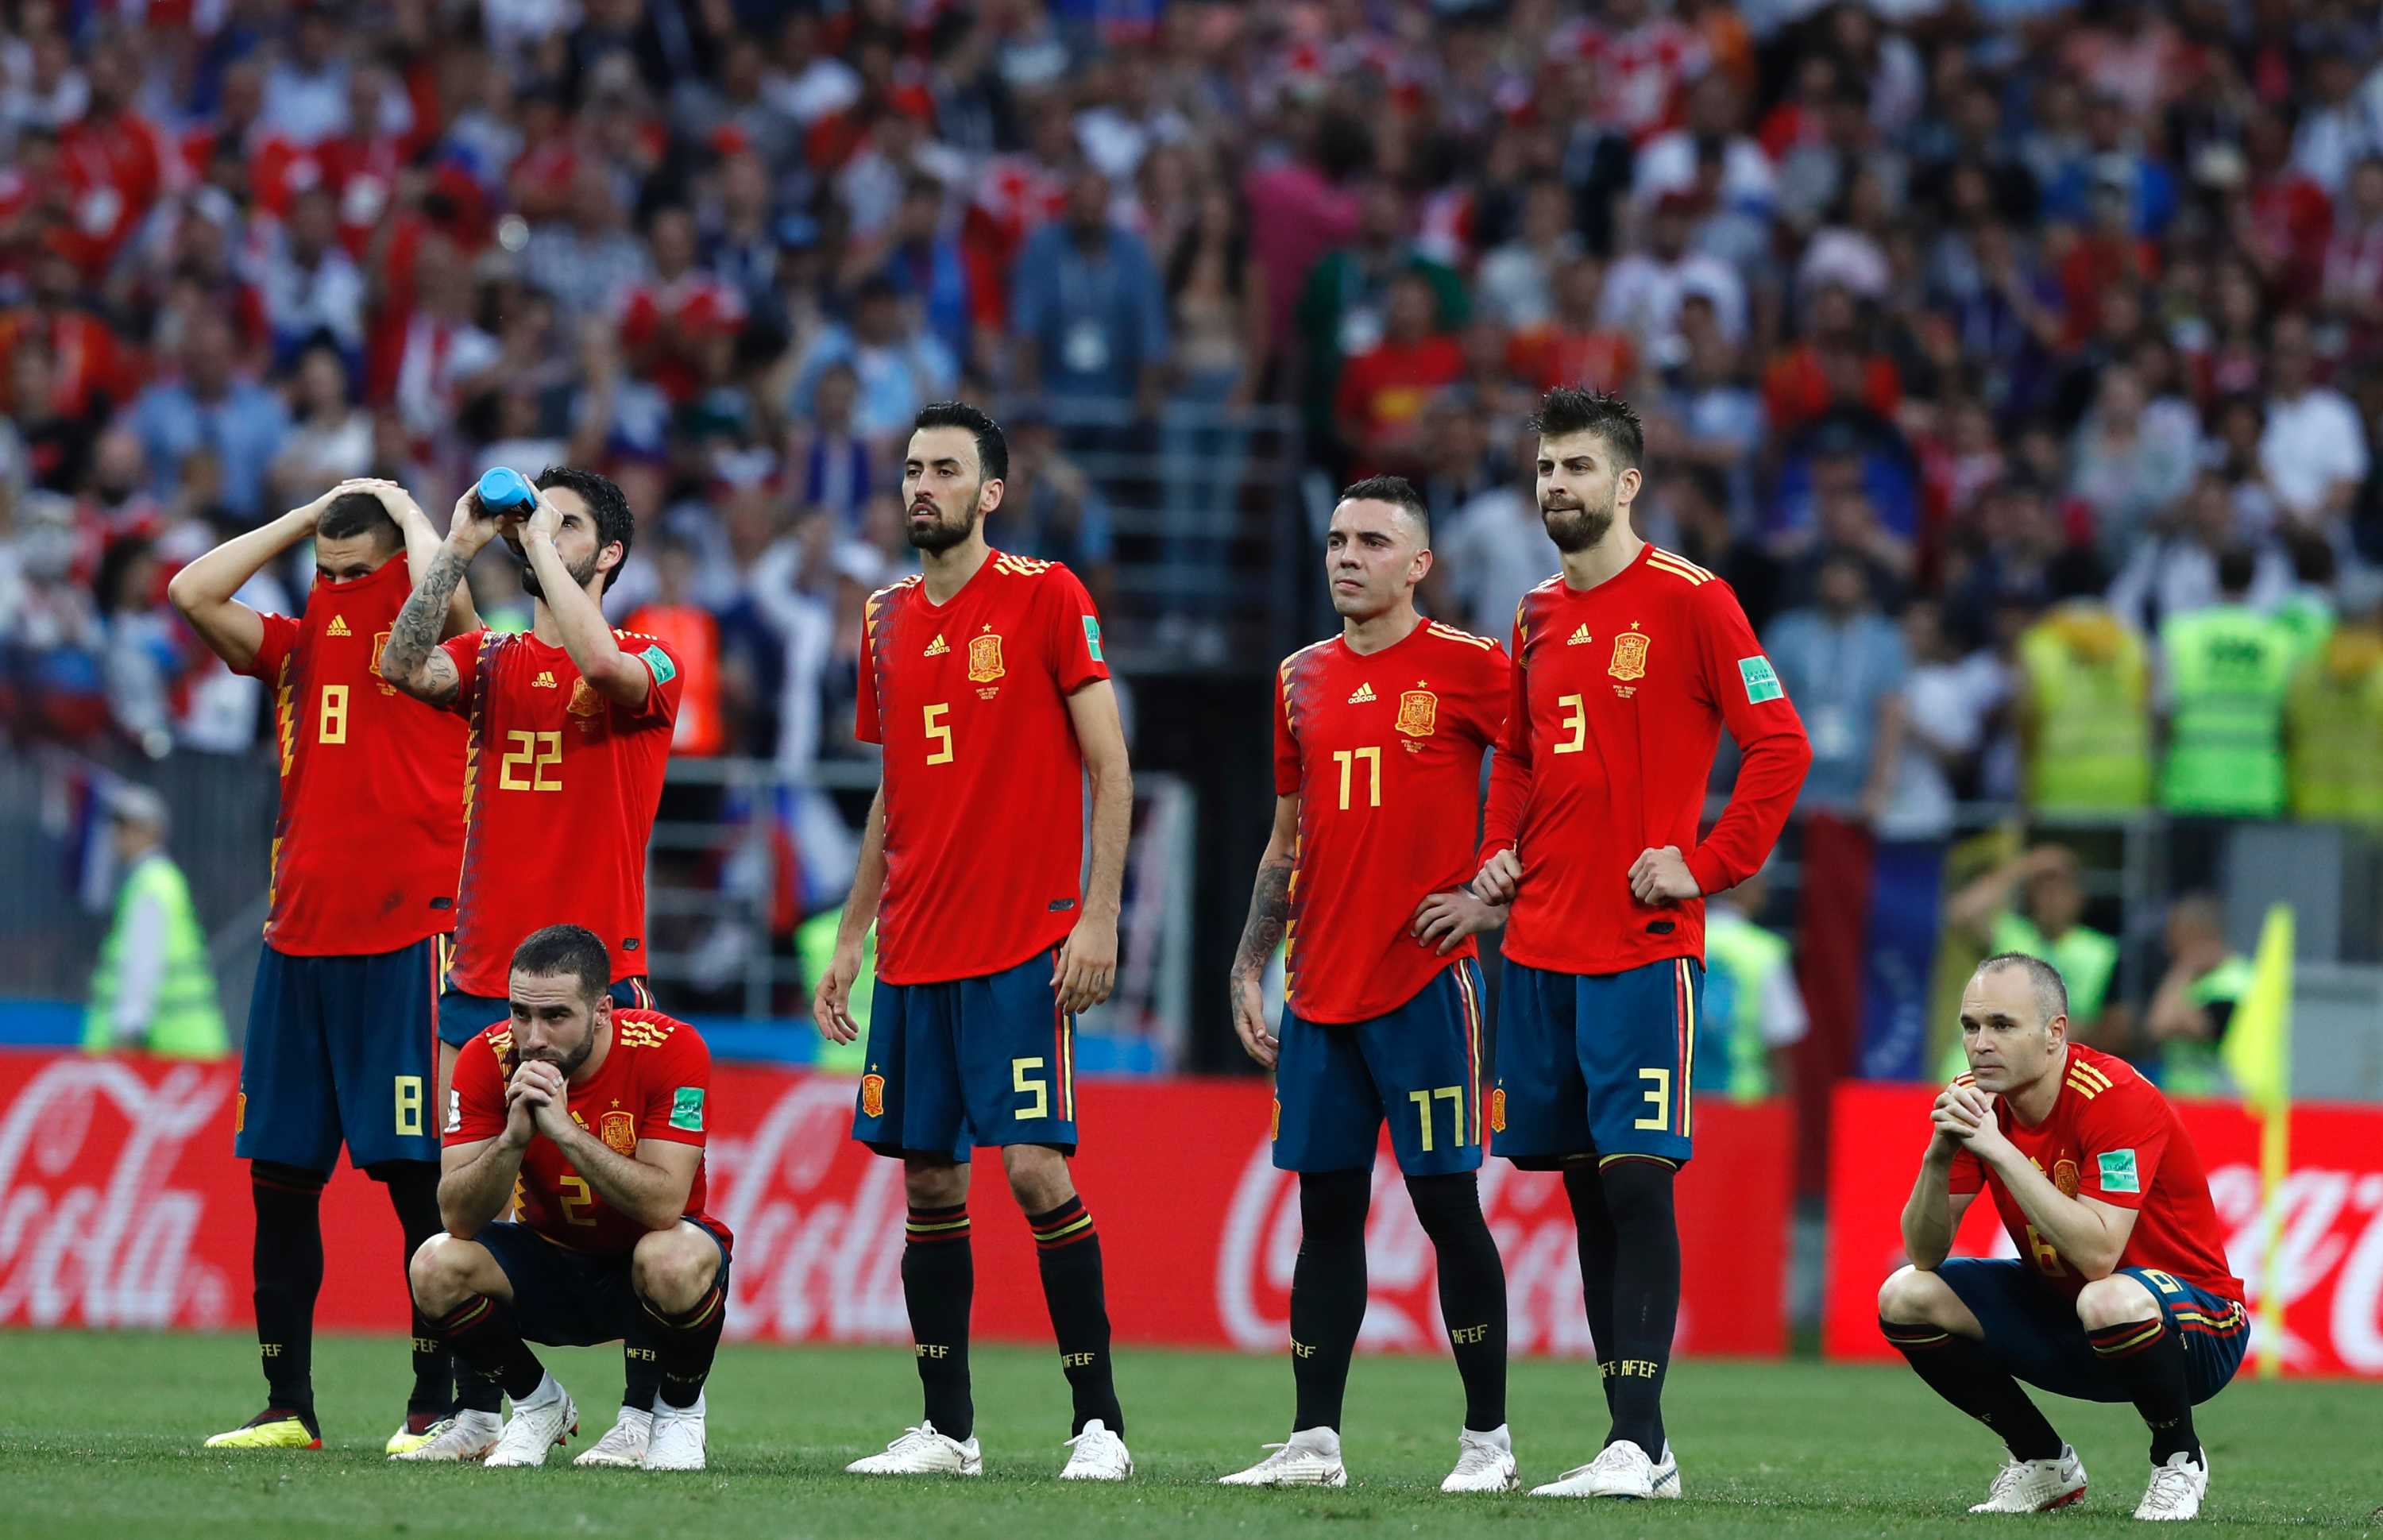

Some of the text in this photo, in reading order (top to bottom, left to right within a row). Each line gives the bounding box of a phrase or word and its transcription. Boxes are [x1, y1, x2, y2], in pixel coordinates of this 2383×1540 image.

[923, 645, 951, 658] adidas
[1567, 635, 1593, 646] adidas
[319, 685, 350, 744] 8
[1347, 693, 1377, 704] adidas
[1553, 693, 1586, 755] 3
[499, 730, 562, 791] 22
[923, 702, 954, 766] 5
[1332, 746, 1381, 810] 17
[394, 1075, 423, 1136] 8
[1011, 1056, 1048, 1120] 5
[1408, 1085, 1464, 1152] 17
[1634, 1067, 1670, 1131] 3
[559, 1175, 597, 1227] 2
